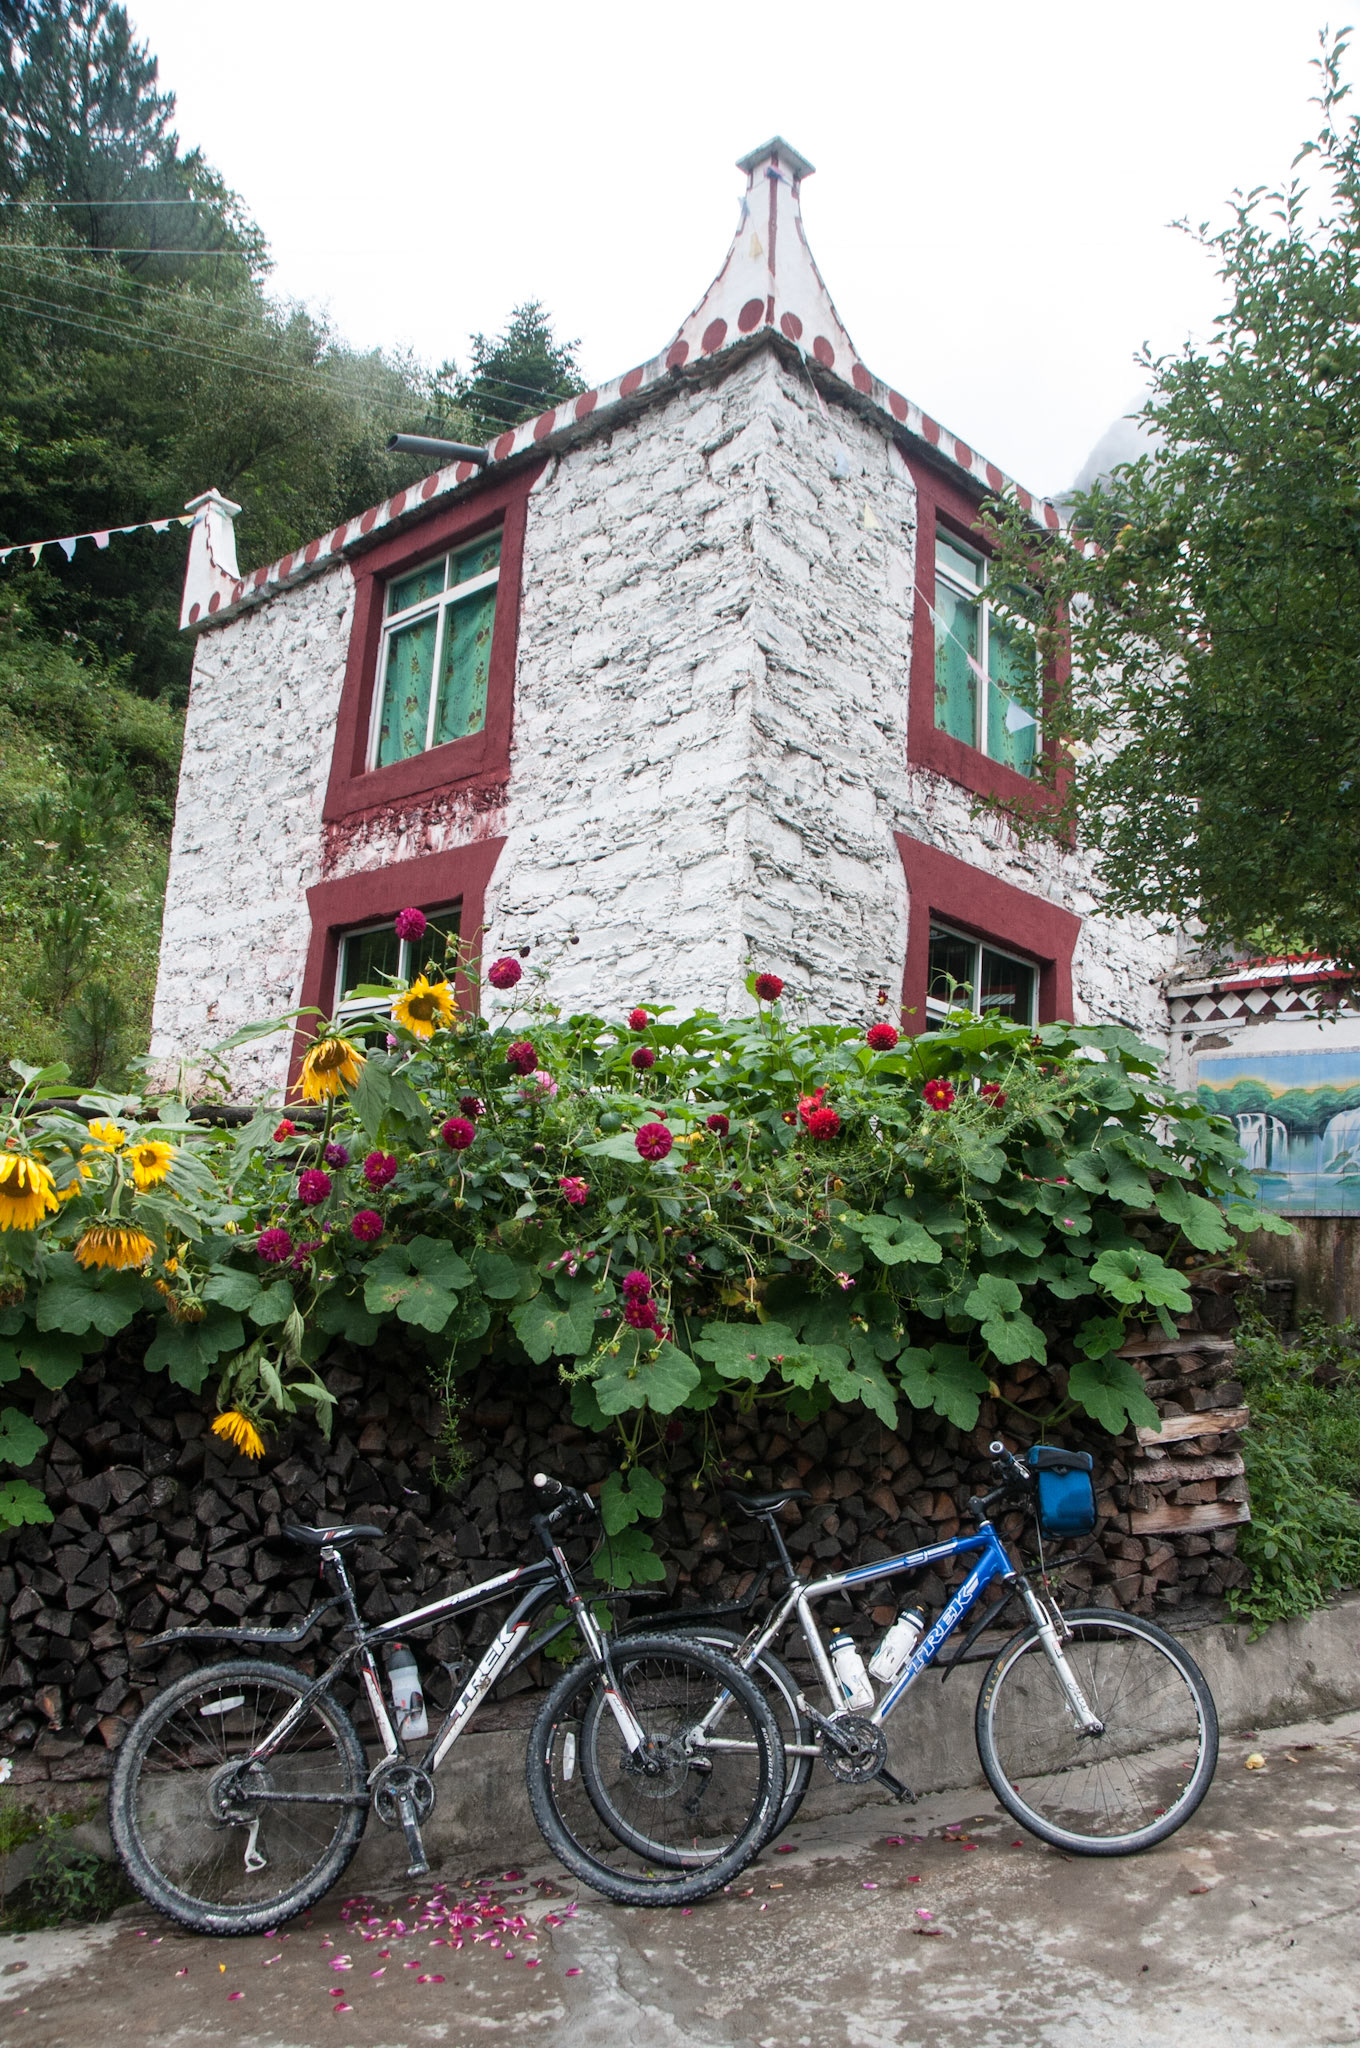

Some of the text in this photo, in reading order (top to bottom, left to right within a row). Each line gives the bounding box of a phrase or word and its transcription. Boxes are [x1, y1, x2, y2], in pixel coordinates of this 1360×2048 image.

[450, 1624, 517, 1718] TREK
[906, 1585, 973, 1674] TREK
[761, 1727, 773, 1779] BONTRAGER
